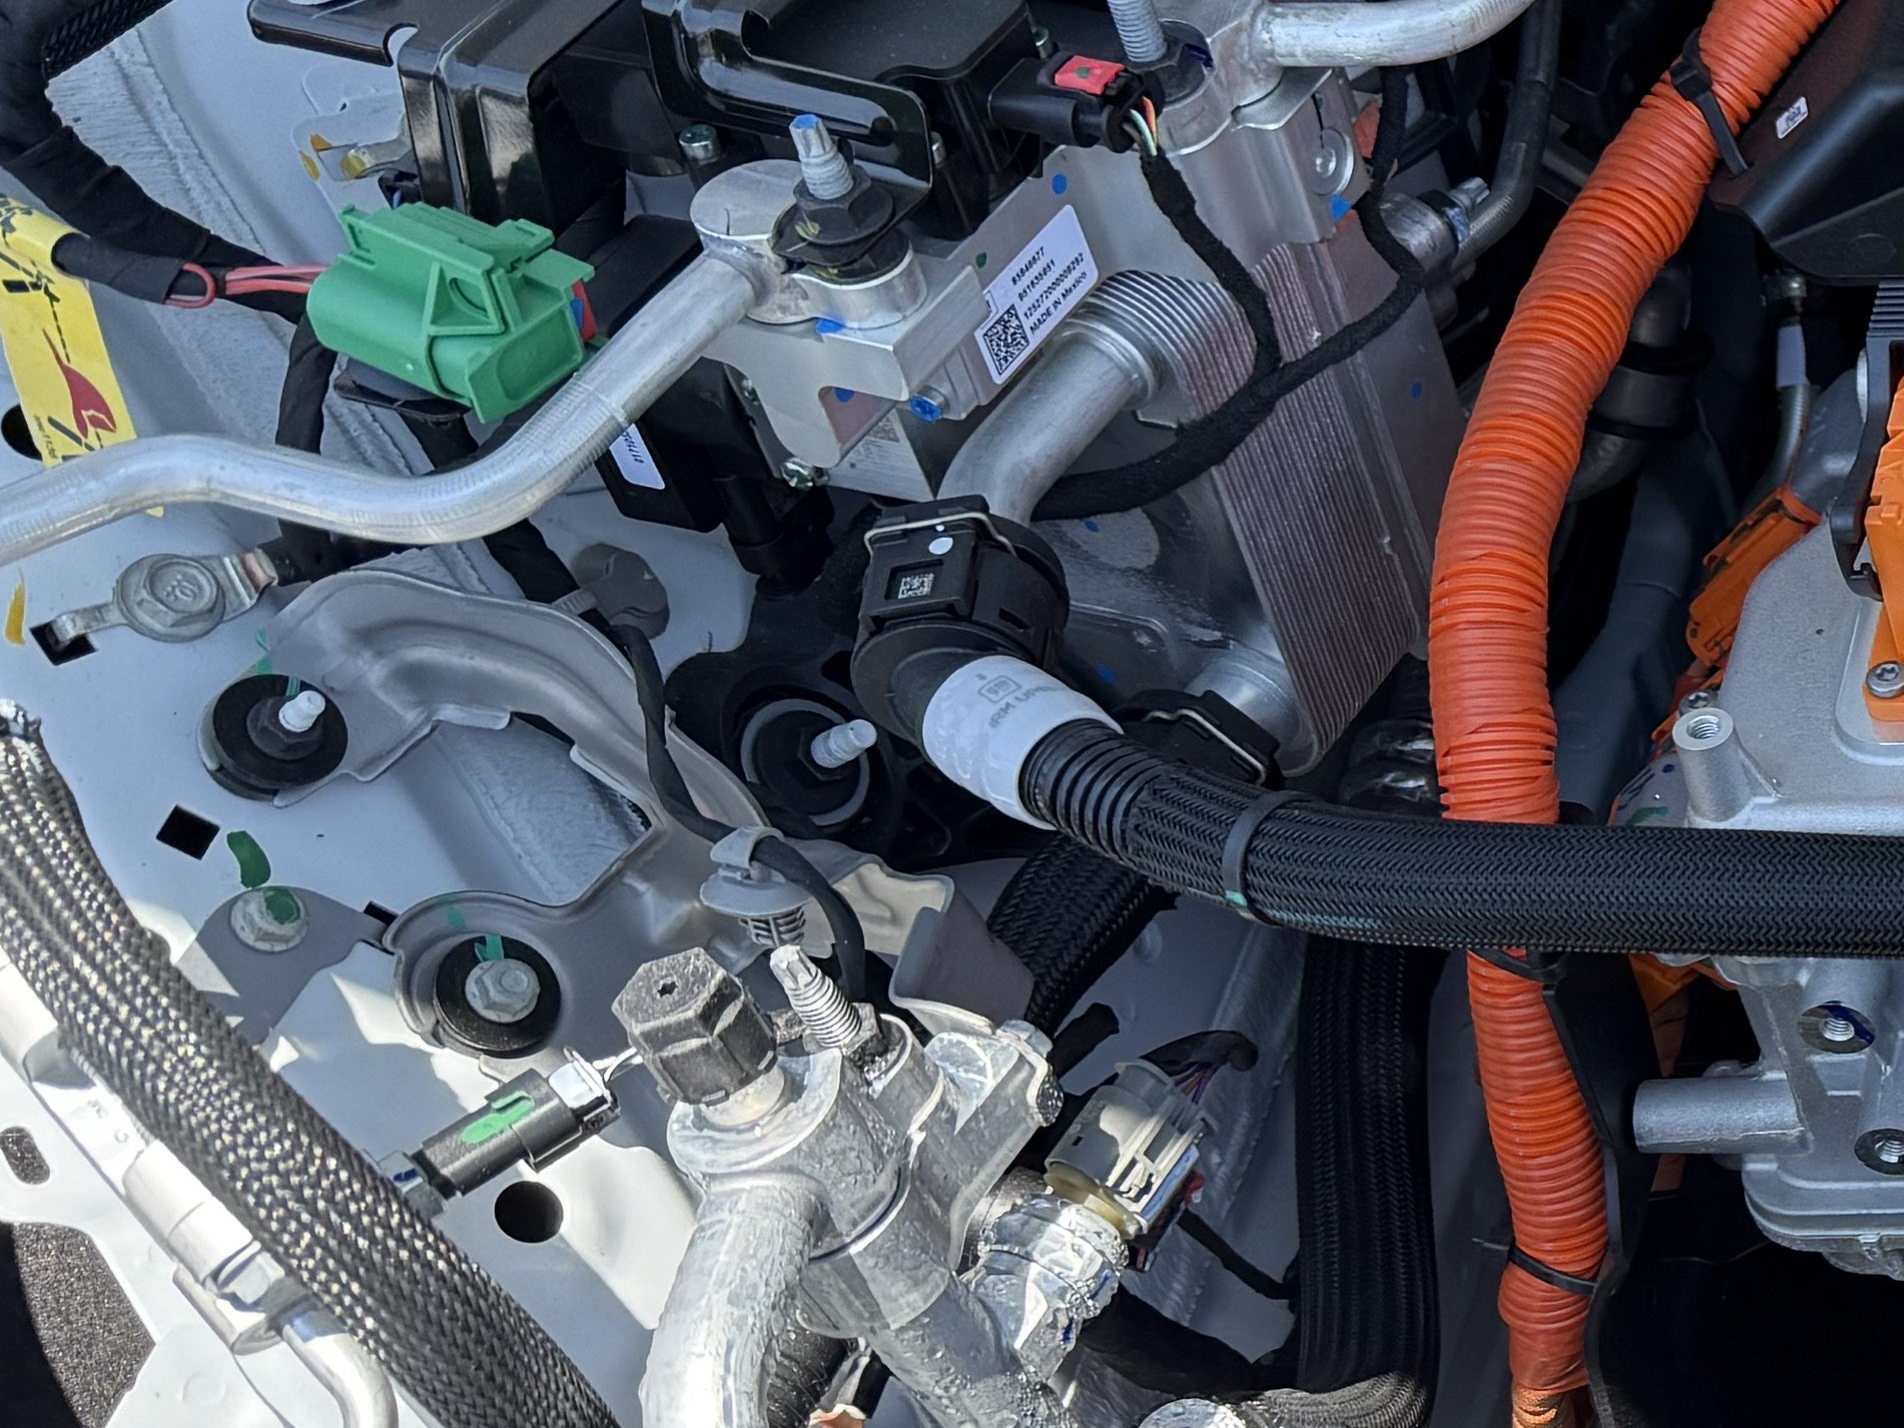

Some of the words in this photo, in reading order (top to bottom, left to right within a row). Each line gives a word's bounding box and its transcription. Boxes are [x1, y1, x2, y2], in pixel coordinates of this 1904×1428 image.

[1029, 306, 1053, 335] MADE
[1052, 297, 1063, 312] IN
[1061, 271, 1088, 300] Mexico
